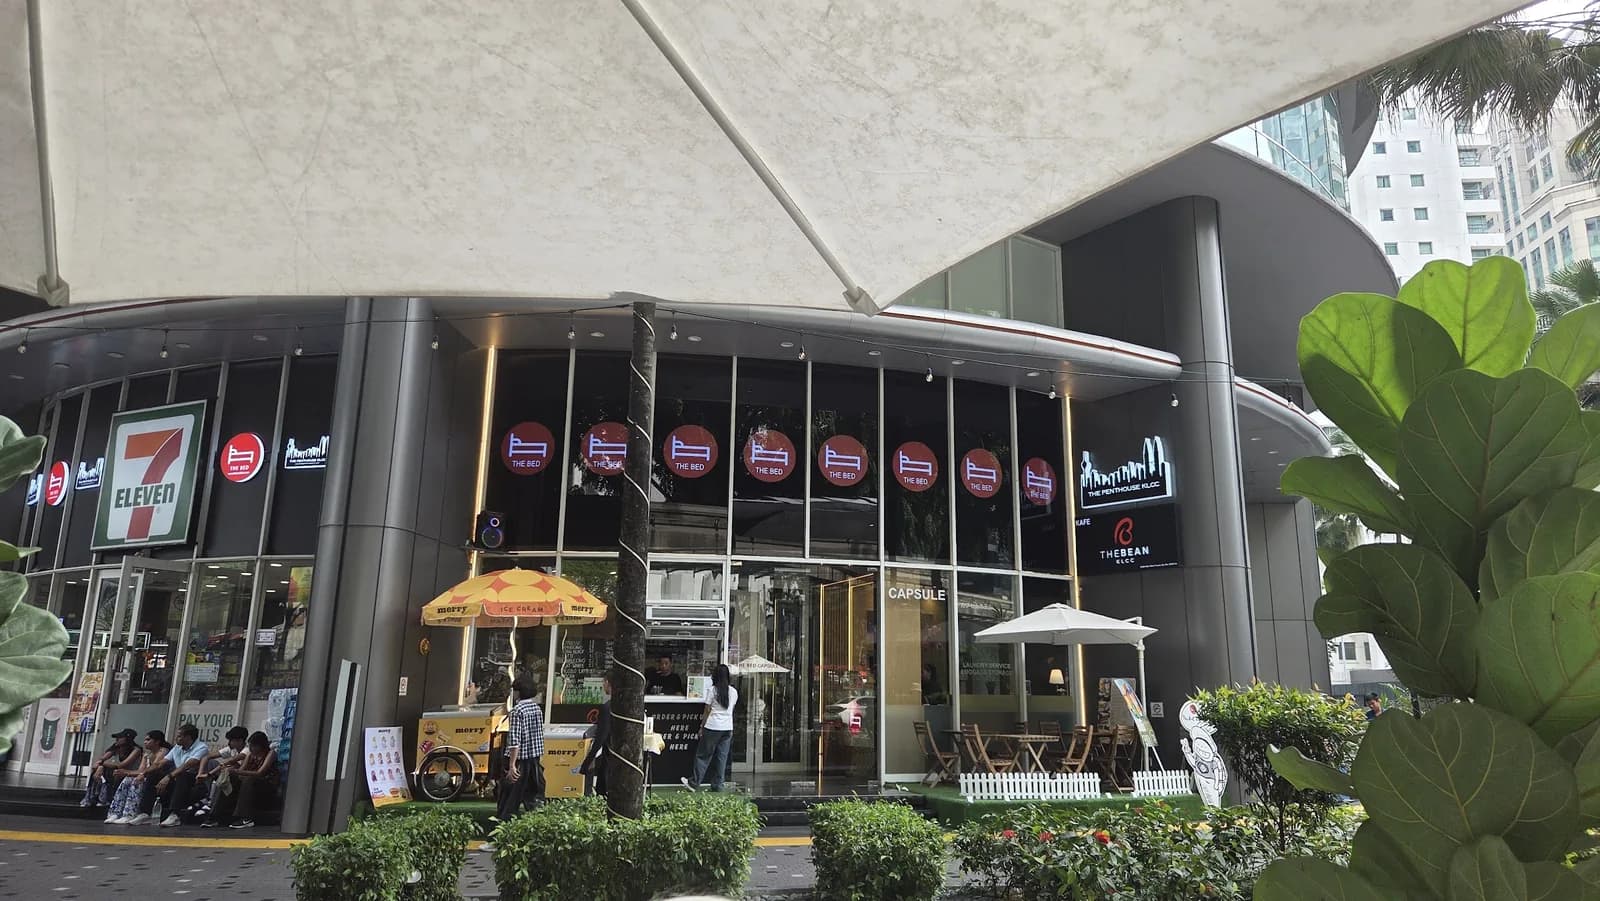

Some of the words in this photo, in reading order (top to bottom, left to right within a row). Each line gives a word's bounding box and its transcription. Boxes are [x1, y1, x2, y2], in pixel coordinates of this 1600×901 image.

[526, 460, 541, 468] BED
[593, 460, 607, 468] THE
[675, 462, 689, 470] THE
[690, 463, 705, 471] BED
[755, 466, 768, 474] THE
[769, 467, 783, 475] BED
[829, 471, 842, 479] THE
[842, 472, 856, 480] BED
[124, 427, 184, 543] 7
[903, 476, 915, 484] THE
[915, 477, 928, 485] BED
[971, 483, 981, 491] THE
[982, 484, 993, 492] BED
[1101, 484, 1141, 496] PENTHOUSE
[1141, 481, 1161, 489] KLCC
[888, 587, 946, 601] CAPSULE
[437, 604, 468, 615] merry
[516, 605, 545, 614] CREAM
[571, 605, 594, 614] merry
[178, 713, 200, 727] PAY
[203, 713, 233, 728] YOUR
[455, 727, 486, 735] merry
[199, 729, 220, 743] LLS
[669, 743, 689, 751] HERE
[547, 749, 578, 757] merry
